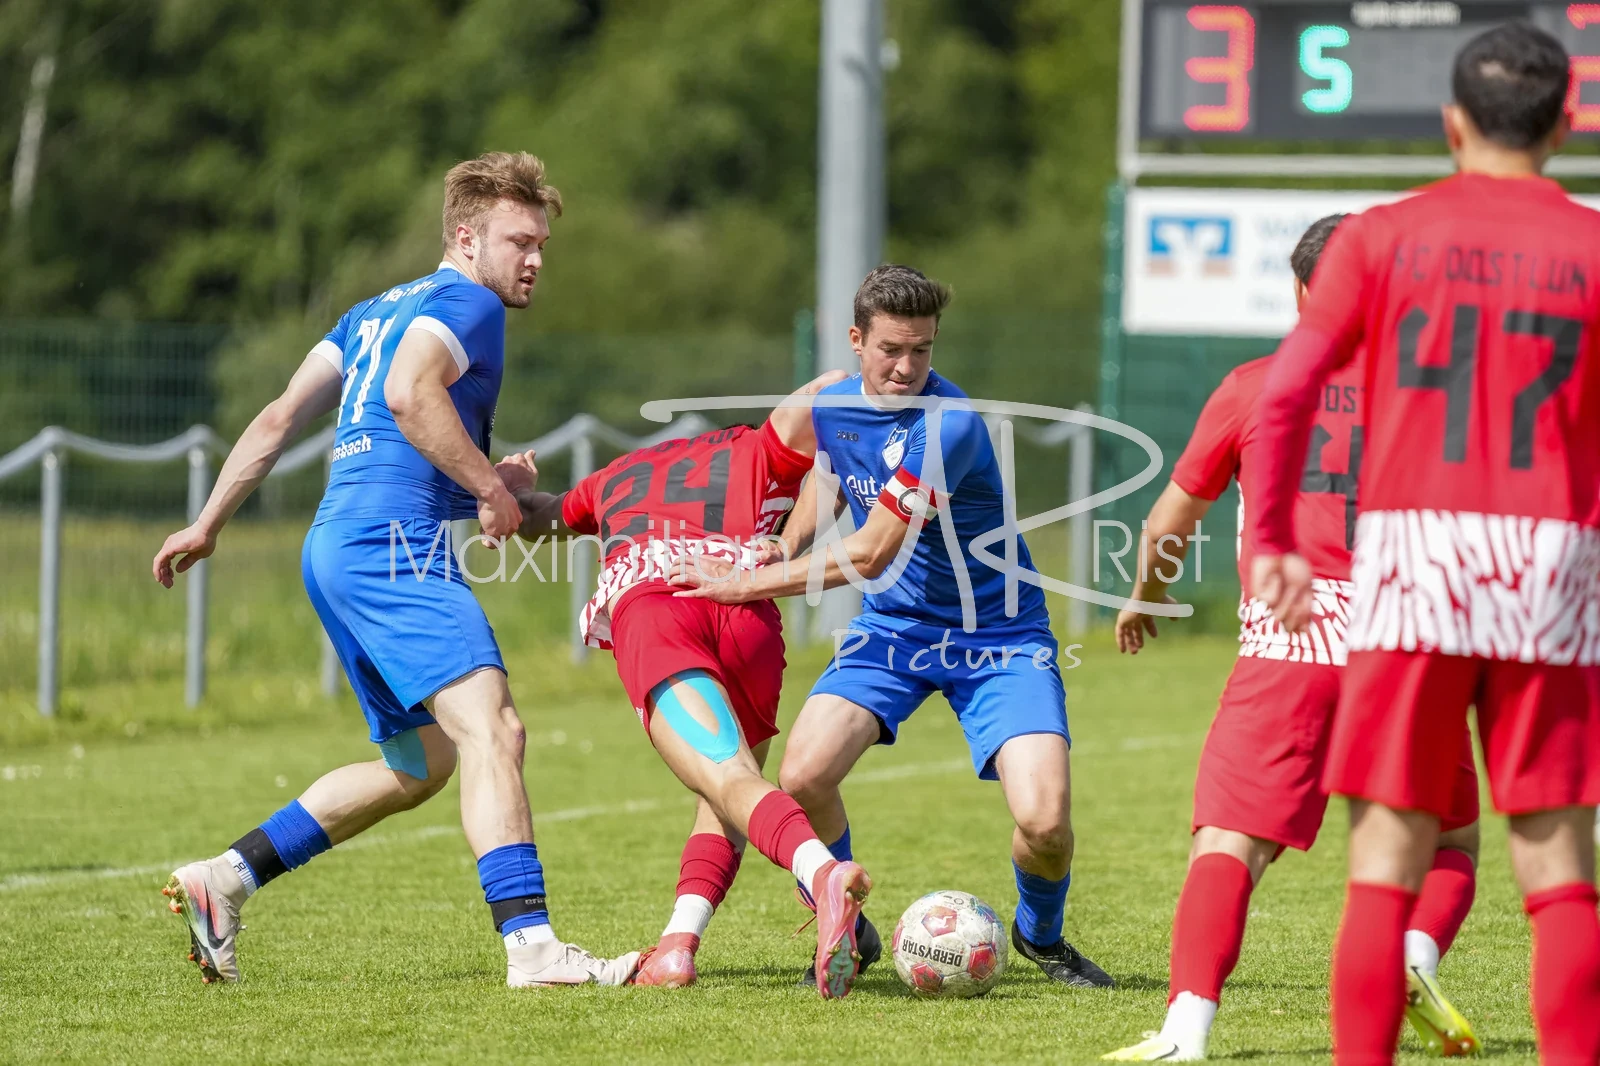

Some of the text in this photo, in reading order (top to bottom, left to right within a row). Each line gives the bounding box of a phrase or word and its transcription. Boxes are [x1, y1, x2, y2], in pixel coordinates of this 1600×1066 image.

[1184, 5, 1254, 131] 3
[1300, 25, 1352, 112] 5
[1397, 305, 1583, 470] 47
[601, 448, 731, 558] 24
[902, 938, 963, 967] DERBYSTAR
